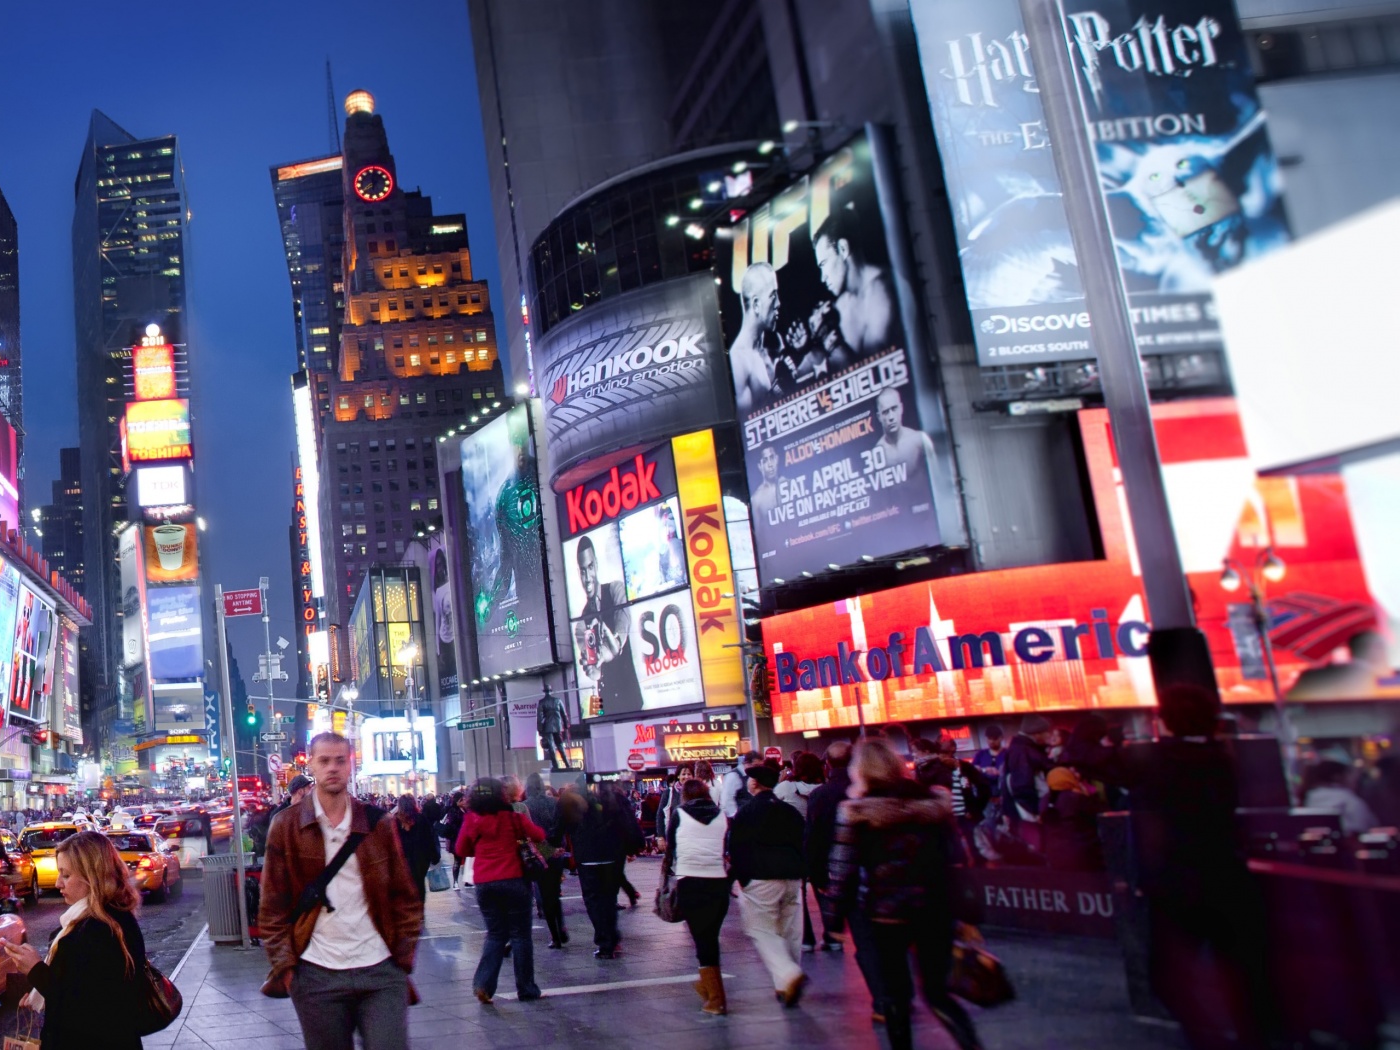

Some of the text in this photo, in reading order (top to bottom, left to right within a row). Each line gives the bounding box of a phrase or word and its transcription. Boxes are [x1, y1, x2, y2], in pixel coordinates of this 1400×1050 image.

[940, 11, 1221, 110] Har Potter
[980, 131, 1014, 147] THE
[988, 340, 1089, 357] 2 BLOCKS SOUTH
[585, 357, 705, 399] driving emotion
[745, 396, 818, 446] ST-PIERRE
[830, 358, 908, 409] SHIELDS
[748, 407, 769, 420] WORLD
[832, 346, 896, 380] CHAMPIONSHIP
[130, 445, 191, 460] TOSHIBA
[785, 445, 813, 466] ALDO
[821, 417, 875, 451] HOMINICK
[565, 454, 661, 533] Kodak
[768, 506, 795, 526] LIVE
[797, 497, 813, 516] ON
[815, 463, 907, 511] PAY-PER-VIEW
[780, 445, 887, 503] SAT. APRIL 30
[686, 503, 732, 635] Kodak
[639, 603, 685, 664] SO
[775, 608, 1152, 693] Bank of Americ
[645, 644, 688, 676] Kodak
[462, 721, 489, 729] Broadway
[662, 723, 739, 733] MARQUIS
[666, 746, 738, 761] WONDERLAND
[984, 885, 1070, 914] FATHER
